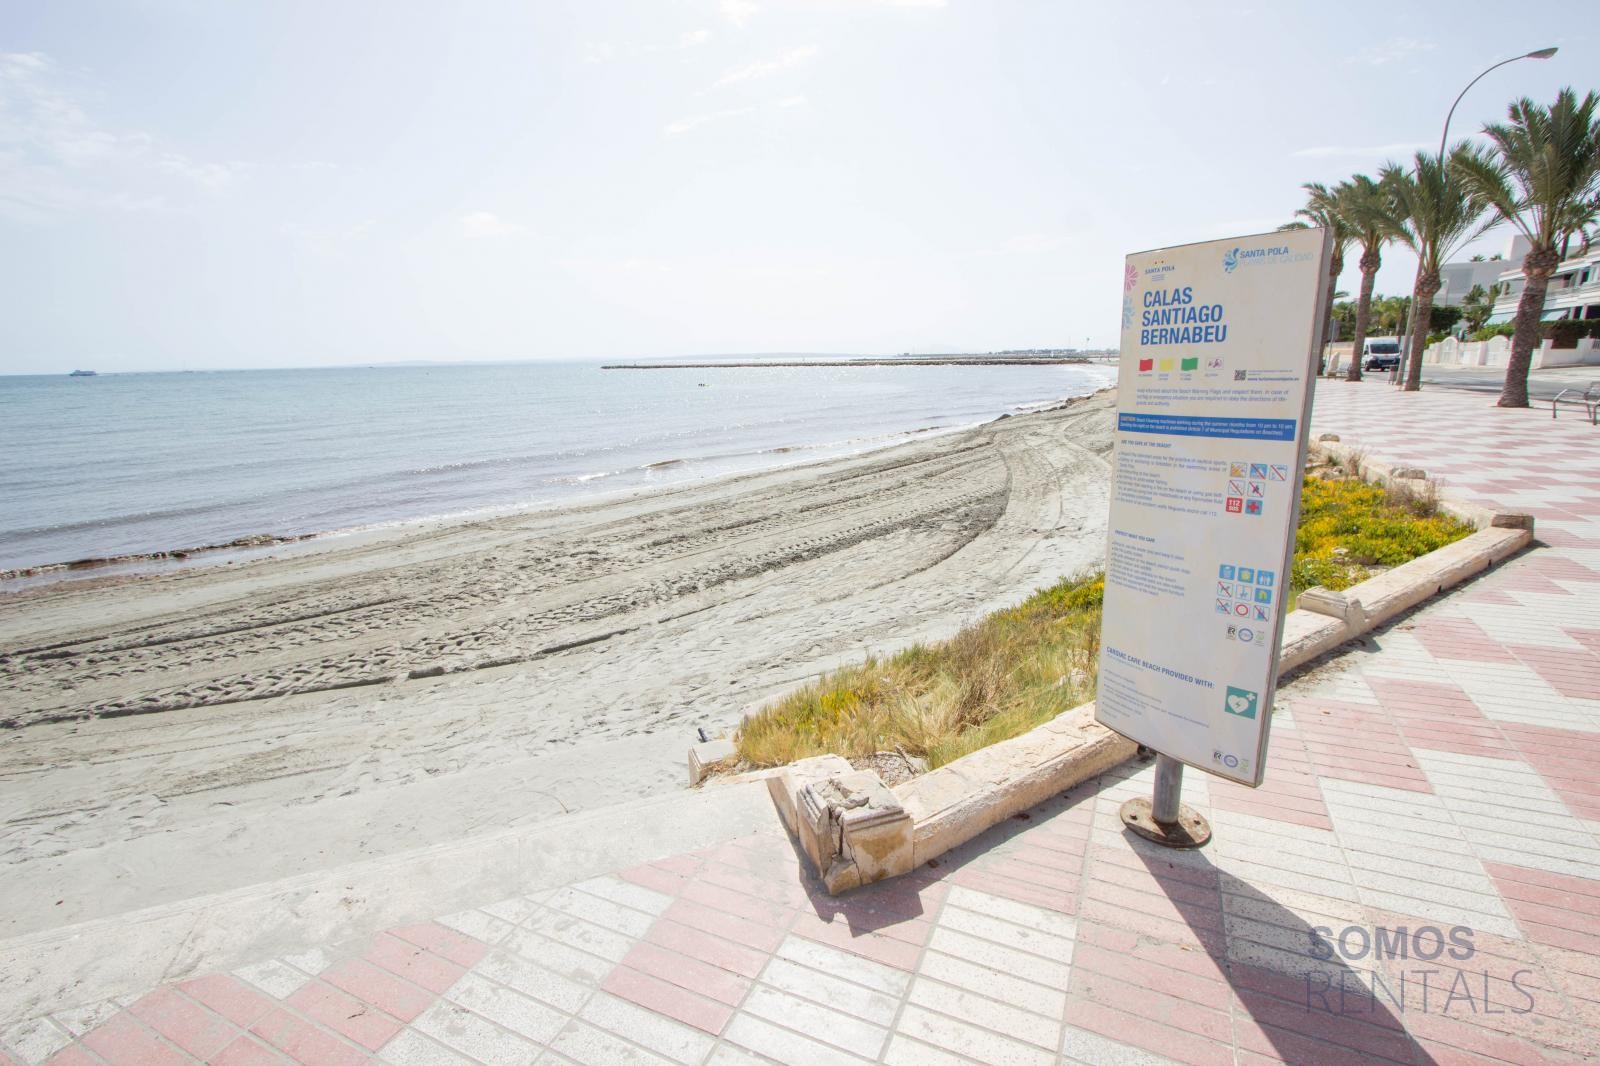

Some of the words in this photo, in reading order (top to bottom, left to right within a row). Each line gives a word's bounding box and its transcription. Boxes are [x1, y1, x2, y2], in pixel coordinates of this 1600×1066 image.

[1240, 248, 1265, 259] SANTA
[1267, 246, 1289, 256] POLA
[1143, 286, 1193, 308] CALAS
[1141, 304, 1223, 327] SANTIAGO
[1140, 324, 1227, 346] BERNABEU
[1229, 499, 1241, 507] 112
[1106, 646, 1127, 660] CARDIAC
[1127, 655, 1141, 666] CARE
[1141, 660, 1161, 672] BEACH
[1161, 667, 1194, 683] PROVIDED
[1194, 677, 1215, 689] WITH:
